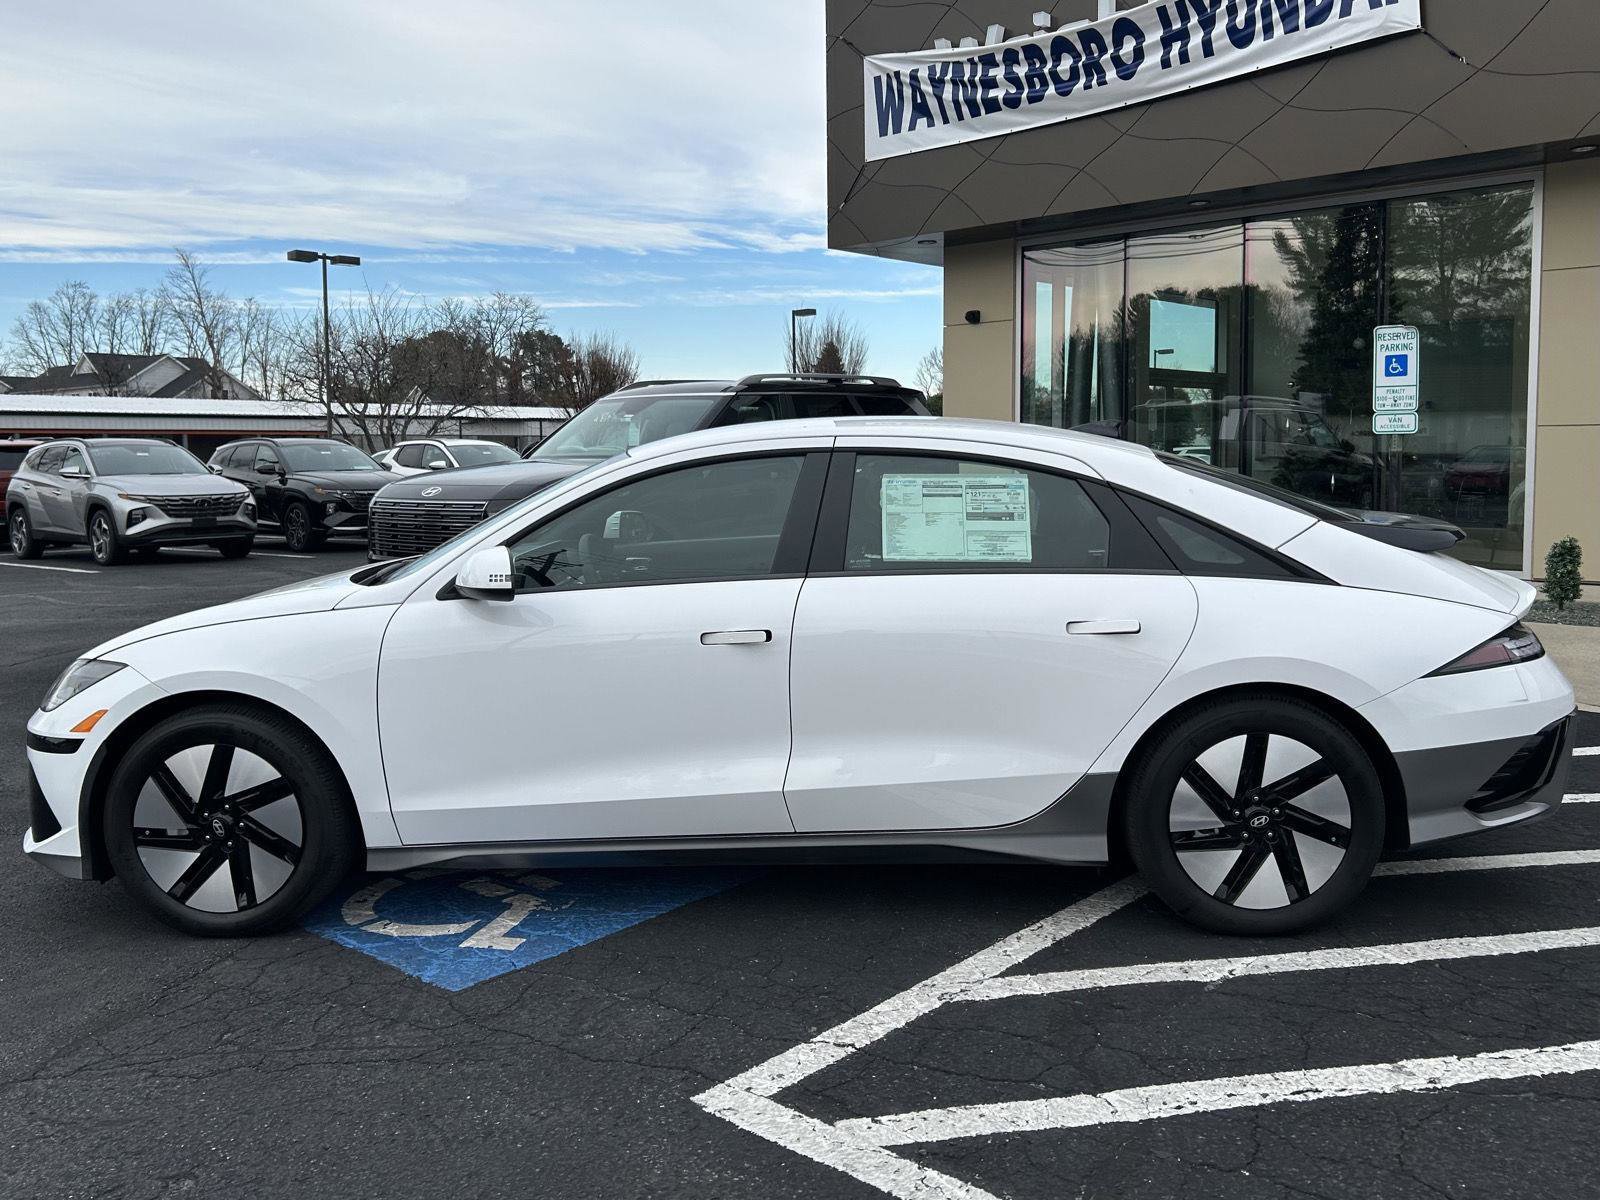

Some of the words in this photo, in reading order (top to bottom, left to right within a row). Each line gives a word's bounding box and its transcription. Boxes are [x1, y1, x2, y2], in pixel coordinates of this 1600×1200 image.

[873, 17, 1146, 138] WAYNESBORO
[1155, 0, 1400, 71] HYUN
[1377, 331, 1416, 341] RESERVED
[1380, 343, 1414, 352] PARKING
